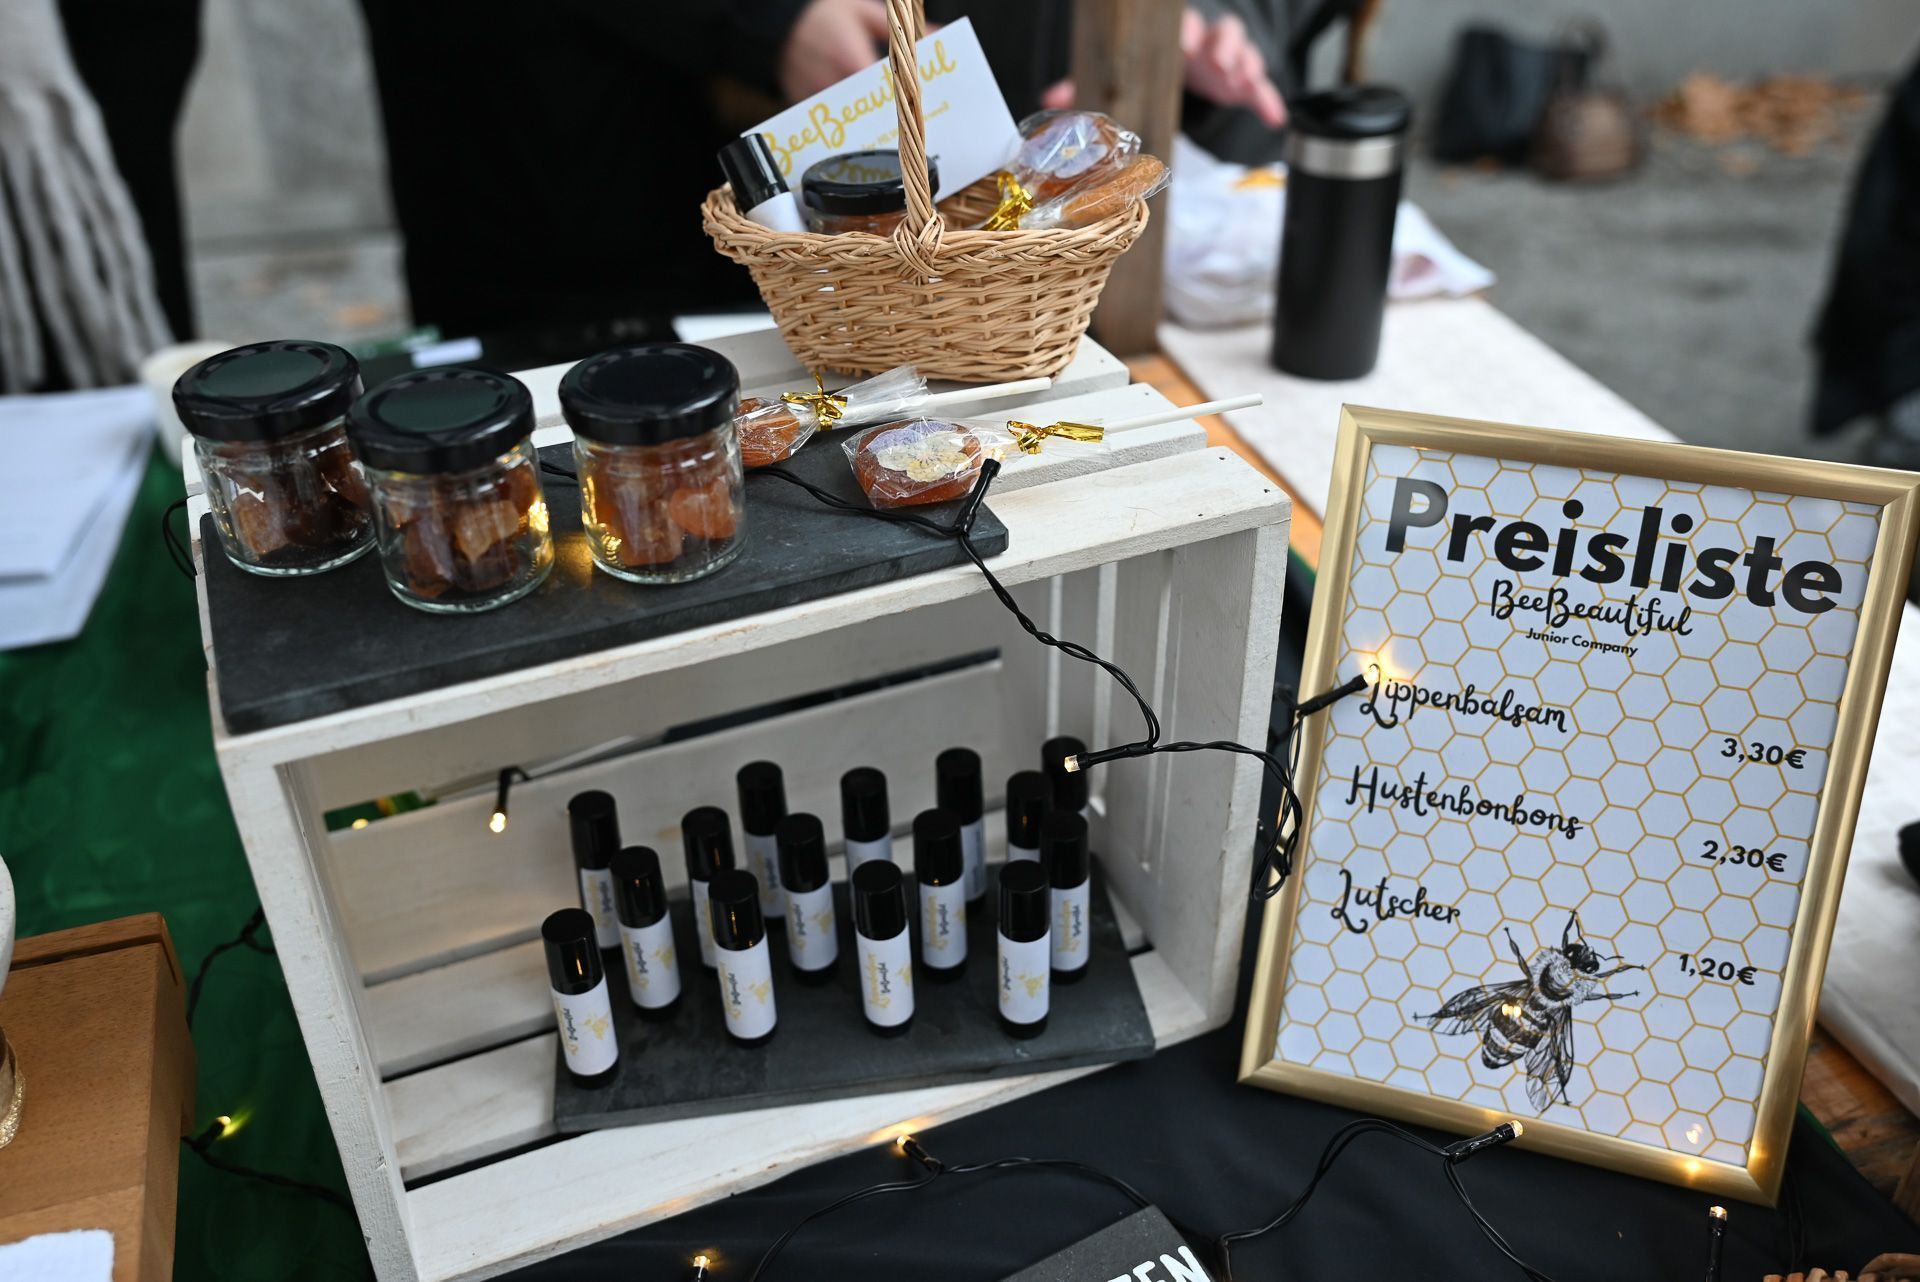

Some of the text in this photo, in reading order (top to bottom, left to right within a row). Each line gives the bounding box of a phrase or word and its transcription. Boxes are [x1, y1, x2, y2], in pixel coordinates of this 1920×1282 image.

[762, 39, 957, 177] BeeBeautul
[1385, 476, 1843, 614] Preisliste
[1491, 579, 1694, 637] BeeBeautiful
[1525, 627, 1639, 658] Junior Company
[1359, 663, 1568, 733] Lippenbalsam
[1720, 737, 1807, 769] 3,30€
[1345, 764, 1584, 840] Hustenbonbons
[1700, 839, 1788, 873] 2,30€
[1330, 868, 1461, 934] Lutscher
[1678, 953, 1758, 986] 1,20€
